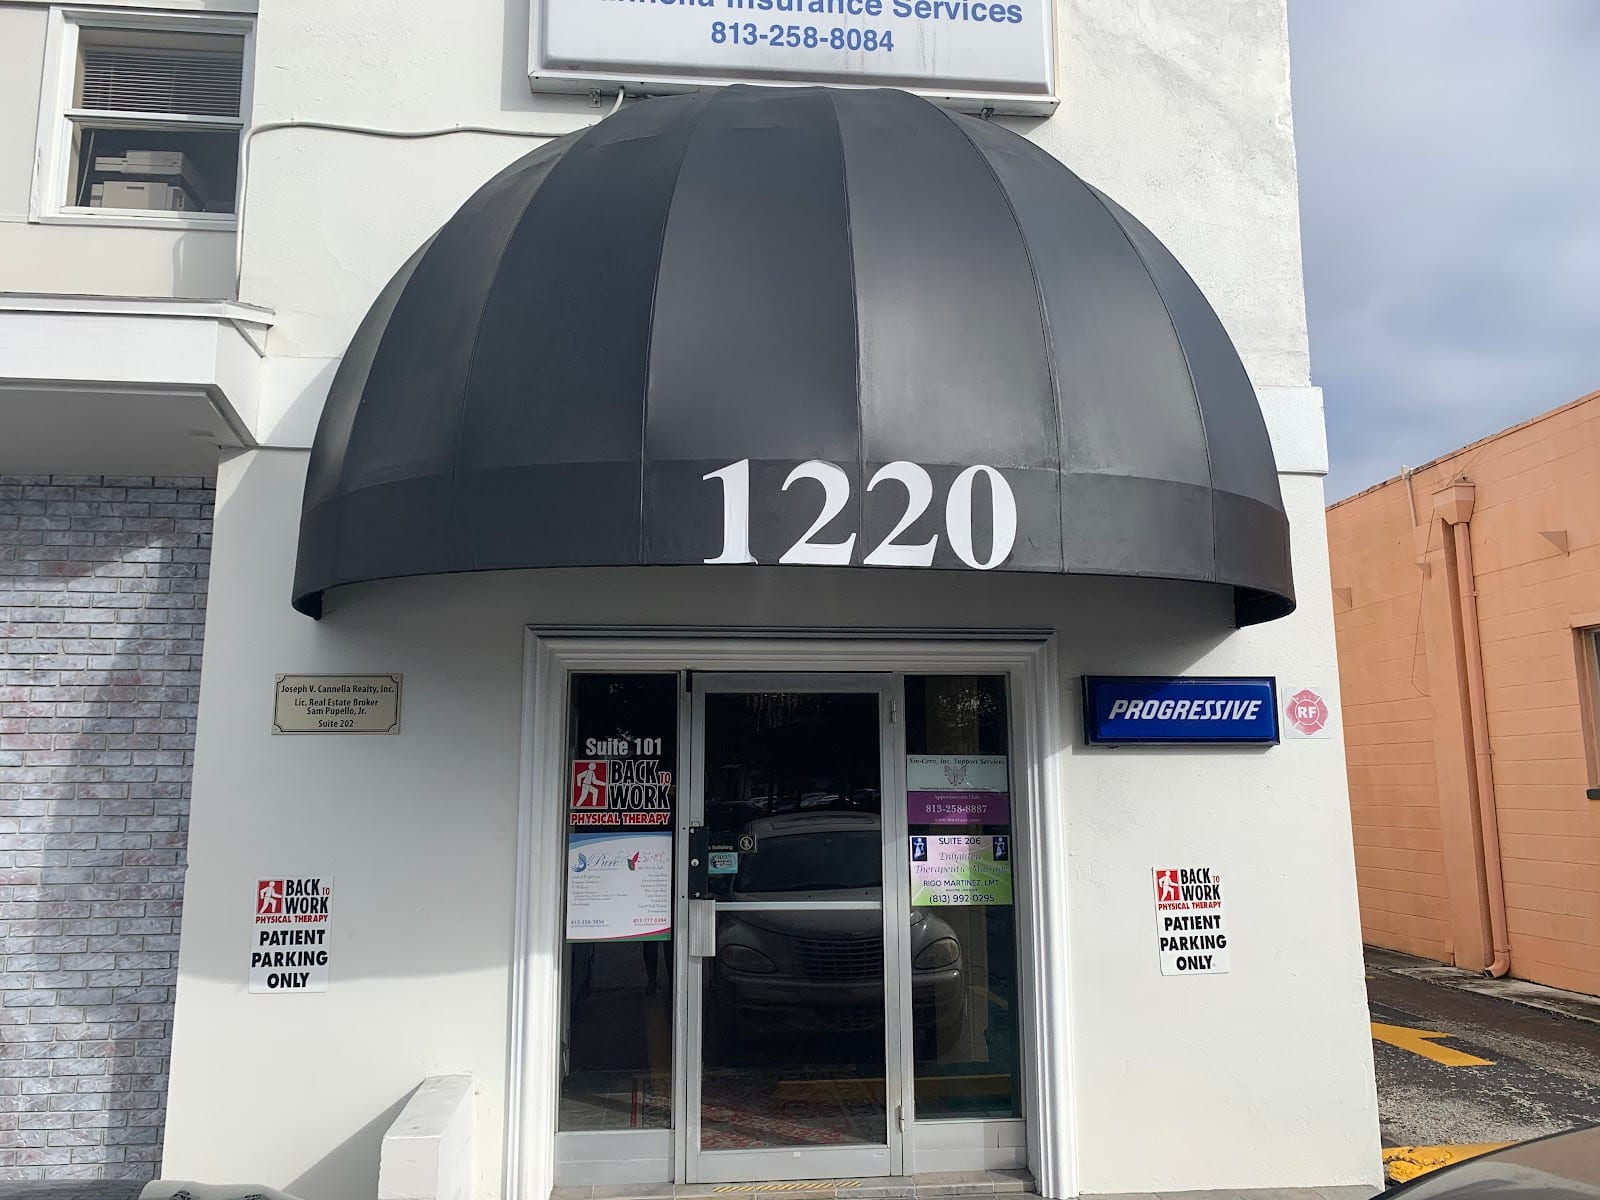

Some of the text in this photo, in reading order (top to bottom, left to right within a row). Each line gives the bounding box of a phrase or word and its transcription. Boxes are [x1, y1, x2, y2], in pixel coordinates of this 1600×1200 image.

[893, 0, 1023, 23] Services
[711, 21, 894, 52] 813-258-8084
[702, 458, 1017, 570] 1220
[281, 685, 395, 694] Joseph V. Cannella Realty, Inc.
[294, 698, 307, 706] Lic.
[309, 698, 326, 706] Real
[327, 699, 351, 707] Estate
[1108, 700, 1262, 720] PROGRESSIVE
[306, 707, 367, 716] Sam Pupello, Jr.
[1297, 707, 1317, 718] RF
[318, 720, 354, 728] Suite 202
[586, 738, 662, 756] Suite 101
[953, 758, 978, 767] Support
[610, 760, 672, 784] BACK TO
[609, 784, 671, 809] WORK
[925, 804, 988, 813] 813-258-8887
[570, 812, 670, 825] PHYSICAL THERAPY
[938, 837, 981, 845] SUITE 206
[1180, 867, 1220, 884] BACK TO
[286, 879, 331, 896] BACK TO
[1181, 884, 1221, 901] WORK
[285, 896, 329, 914] WORK
[929, 894, 995, 904] (813) 992-0295
[1158, 901, 1222, 911] PHYSICAL THERAPY
[255, 914, 329, 924] PHYSICAL THERAPY
[1164, 915, 1221, 931] PATIENT
[259, 930, 325, 946] PATIENT
[1159, 934, 1227, 951] PARKING
[251, 951, 328, 968] PARKING
[1176, 955, 1213, 970] ONLY
[267, 972, 310, 988] ONLY
